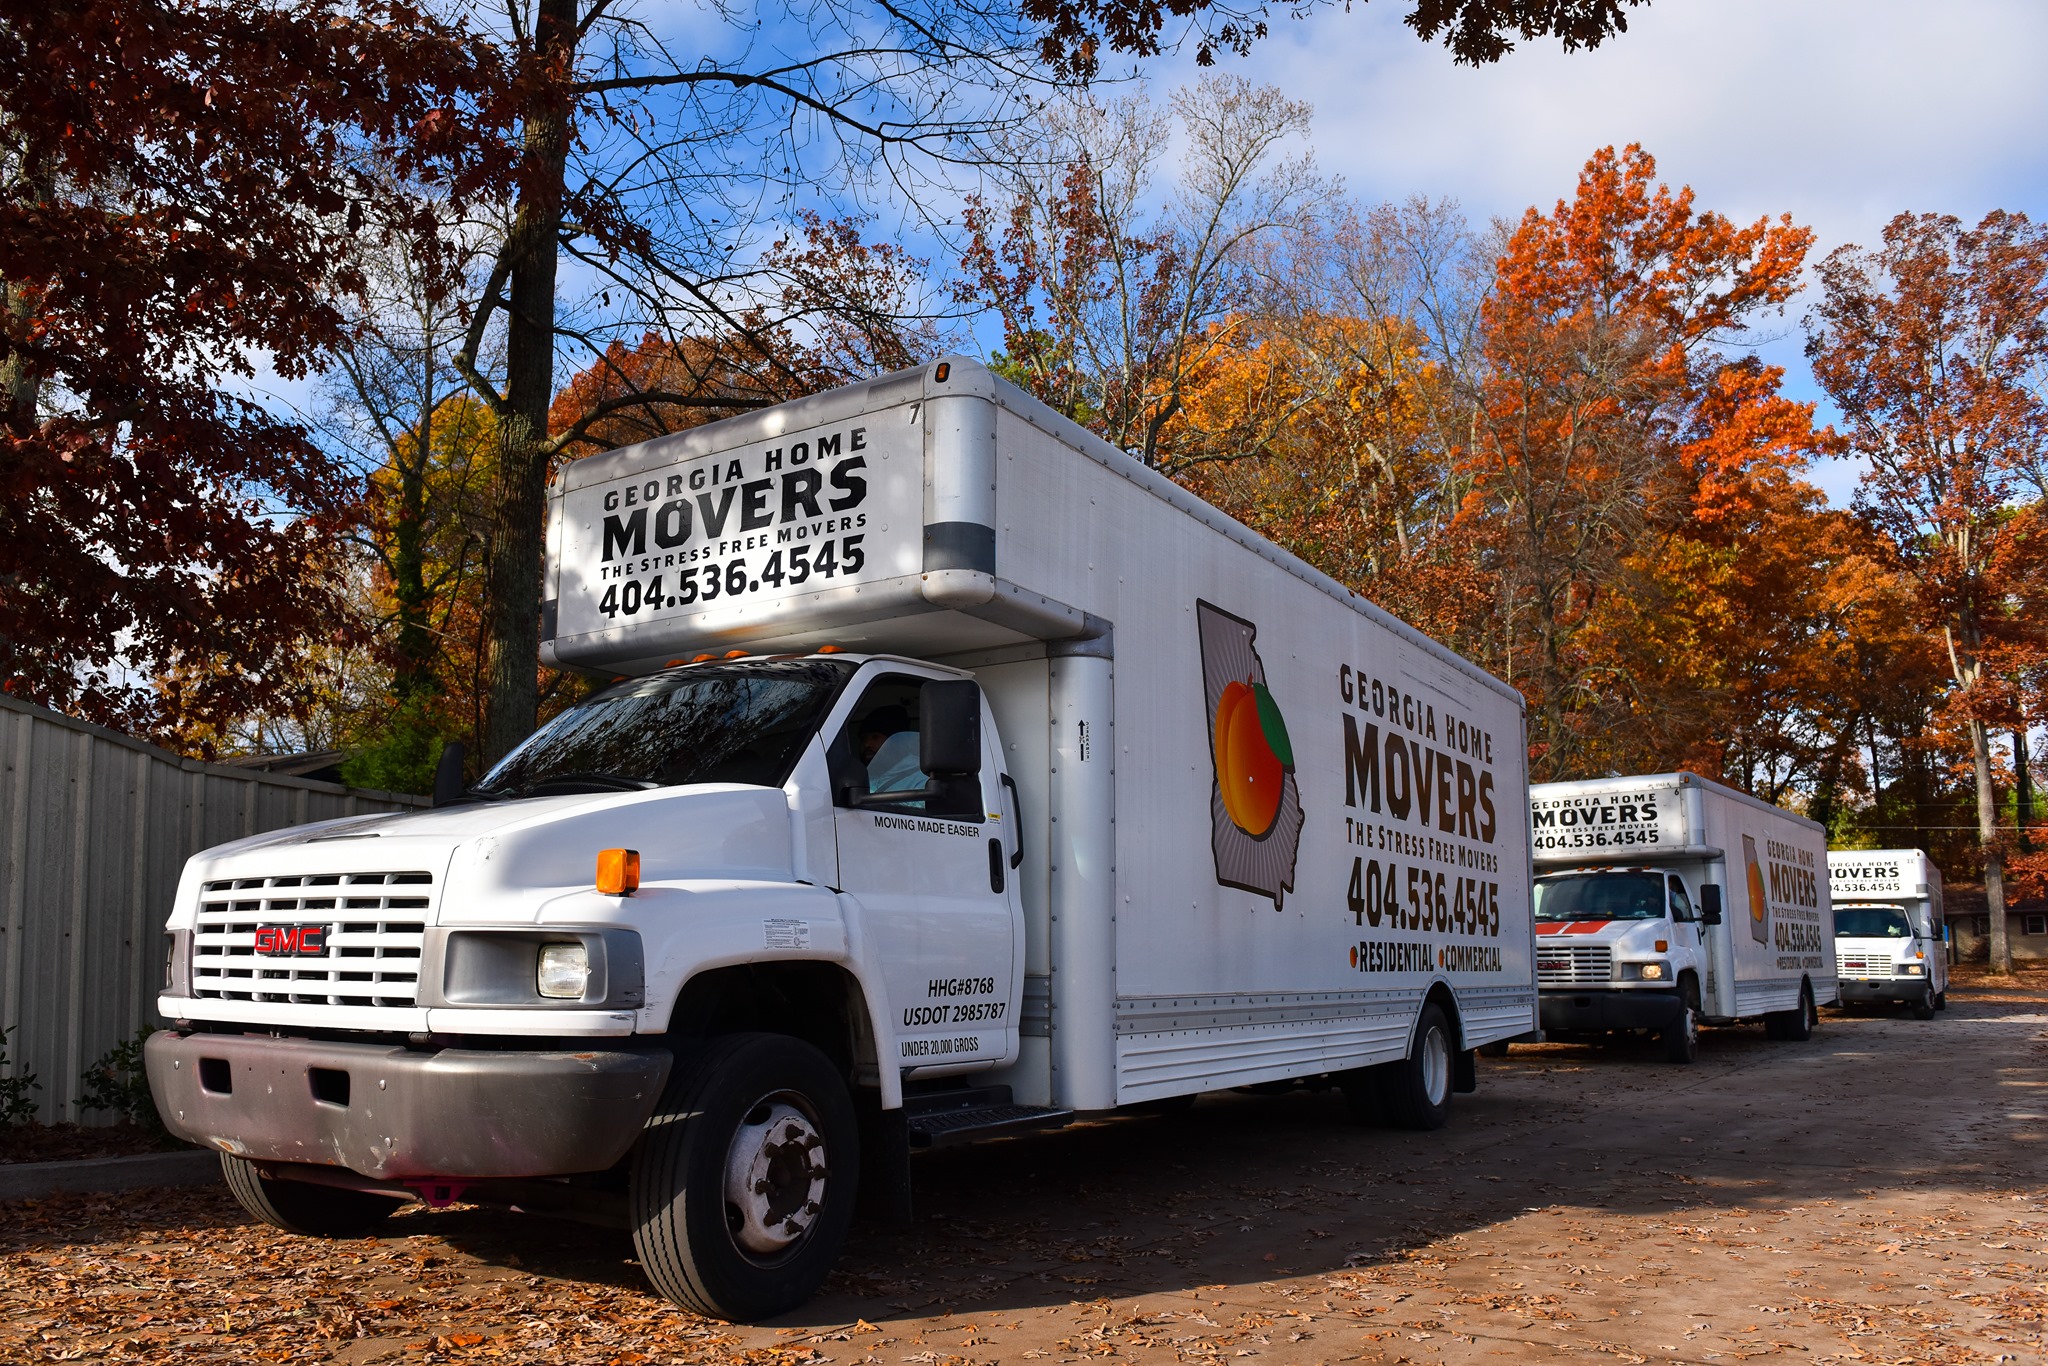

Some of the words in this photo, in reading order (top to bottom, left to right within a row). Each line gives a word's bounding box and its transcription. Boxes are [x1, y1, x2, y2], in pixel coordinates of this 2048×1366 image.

[910, 403, 921, 424] 7
[604, 459, 743, 512] GEORGIA
[765, 427, 867, 472] HOME
[601, 455, 867, 562] MOVERS
[601, 563, 634, 580] THE
[641, 546, 710, 572] STRESS
[719, 533, 768, 556] FREE
[777, 513, 867, 544] MOVERS
[599, 533, 865, 618] 404.536.4545
[1340, 663, 1436, 741] GEORGIA
[1445, 714, 1493, 765] HOME
[1342, 712, 1497, 844] MOVERS
[1531, 797, 1601, 810] GEORGIA
[1610, 793, 1656, 804] HOME
[1674, 788, 1680, 796] 6
[874, 815, 915, 832] MOVING
[917, 818, 946, 834] MADE
[947, 823, 980, 838] EASIER
[1532, 803, 1658, 829] MOVERS
[1554, 826, 1588, 834] STRESS
[1618, 822, 1659, 830] MOVERS
[1345, 817, 1374, 847] THE
[1379, 826, 1425, 859] STRESS
[1429, 837, 1455, 864] FREE
[1458, 844, 1498, 873] MOVERS
[1534, 829, 1659, 849] 404.536.4545
[1767, 839, 1796, 863] GEORGIA
[1798, 848, 1814, 868] HOME
[1347, 856, 1499, 937] 404.536.4545
[1769, 861, 1817, 908] MOVERS
[1830, 883, 1900, 891] 4.536.4545
[254, 928, 321, 952] GMC
[1359, 941, 1434, 972] RESIDENTIAL
[1445, 944, 1502, 972] COMMERCIAL
[1537, 961, 1570, 970] GMC
[928, 977, 994, 998] HHG#8768
[903, 1005, 950, 1026] USDOT
[952, 1002, 1006, 1023] 2985787
[901, 1039, 929, 1058] UNDER
[930, 1038, 953, 1056] 20,000
[954, 1036, 979, 1053] GROSS
